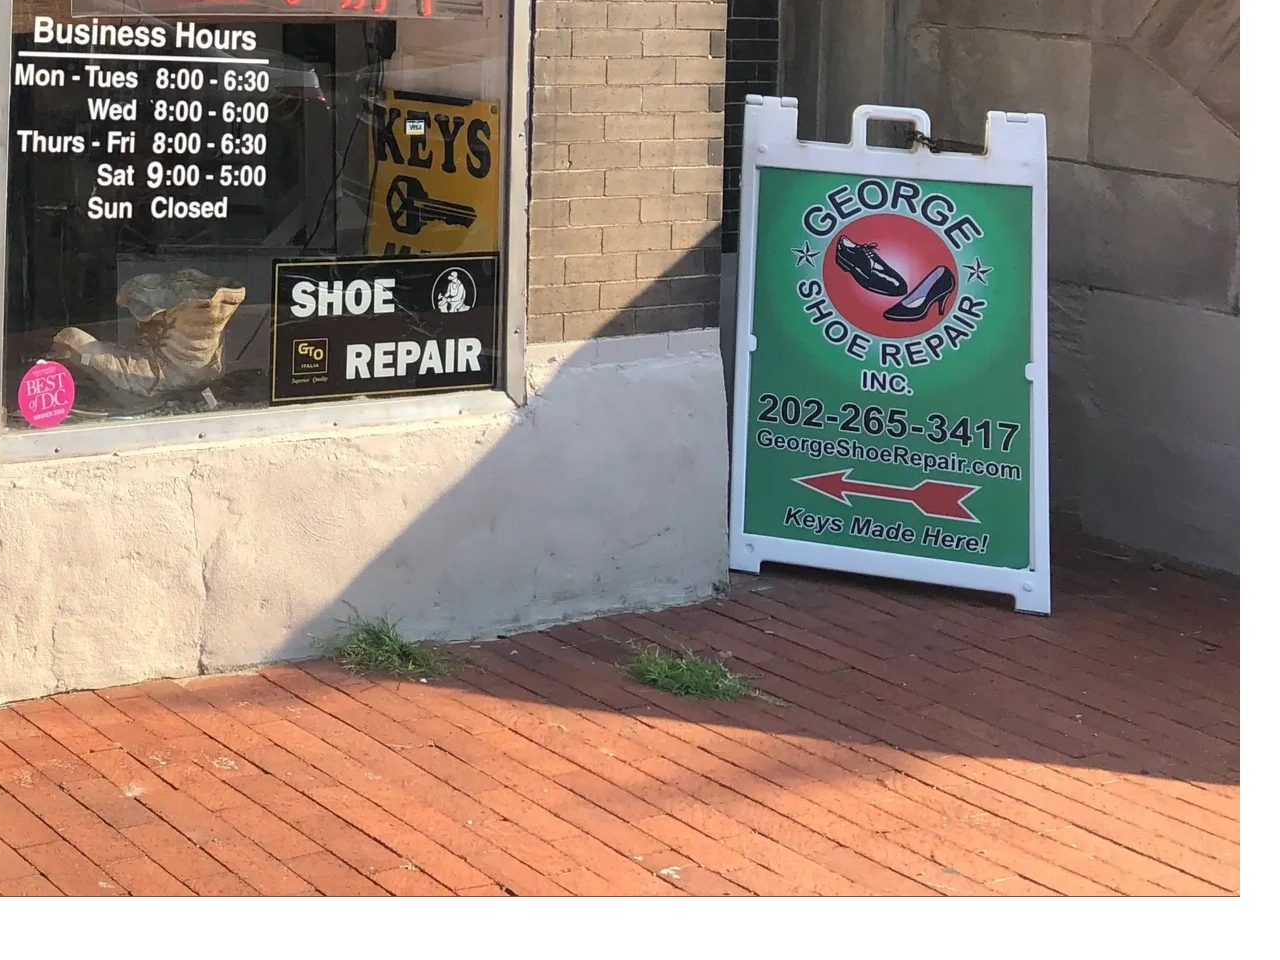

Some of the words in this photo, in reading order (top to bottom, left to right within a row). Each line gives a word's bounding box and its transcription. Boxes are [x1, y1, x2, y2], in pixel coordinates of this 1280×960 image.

[34, 16, 166, 48] Business
[175, 22, 257, 51] Hours
[15, 63, 65, 87] Mon
[85, 65, 139, 88] Tues
[156, 68, 204, 90] 8:00
[224, 70, 270, 92] 6:30
[87, 98, 137, 121] Wed
[153, 100, 203, 122] 8:00
[222, 102, 269, 124] 6:00
[17, 130, 85, 153] Thurs
[107, 131, 135, 154] Fri
[152, 132, 201, 154] 8:00
[221, 133, 267, 155] 6:30
[374, 107, 491, 179] KEYS
[97, 163, 134, 186] Sat
[147, 161, 200, 189] 9:00
[219, 165, 267, 187] 5:00
[87, 197, 133, 219] Sun
[151, 196, 228, 219] Closed
[802, 178, 984, 251] GEORGE
[290, 278, 396, 318] SHOE
[797, 279, 872, 361] SHOE
[880, 294, 987, 368] REPAIR
[298, 343, 324, 360] GTO
[345, 337, 482, 380] REPAIR
[26, 371, 66, 396] BEST
[860, 369, 914, 396] INC.
[29, 394, 41, 412] of
[757, 393, 1021, 452] 202-265-3417
[756, 428, 1021, 480] GeorgeShoeRepair.com
[783, 506, 844, 534] Keys
[850, 516, 916, 544] Made
[921, 526, 990, 554] Here!
